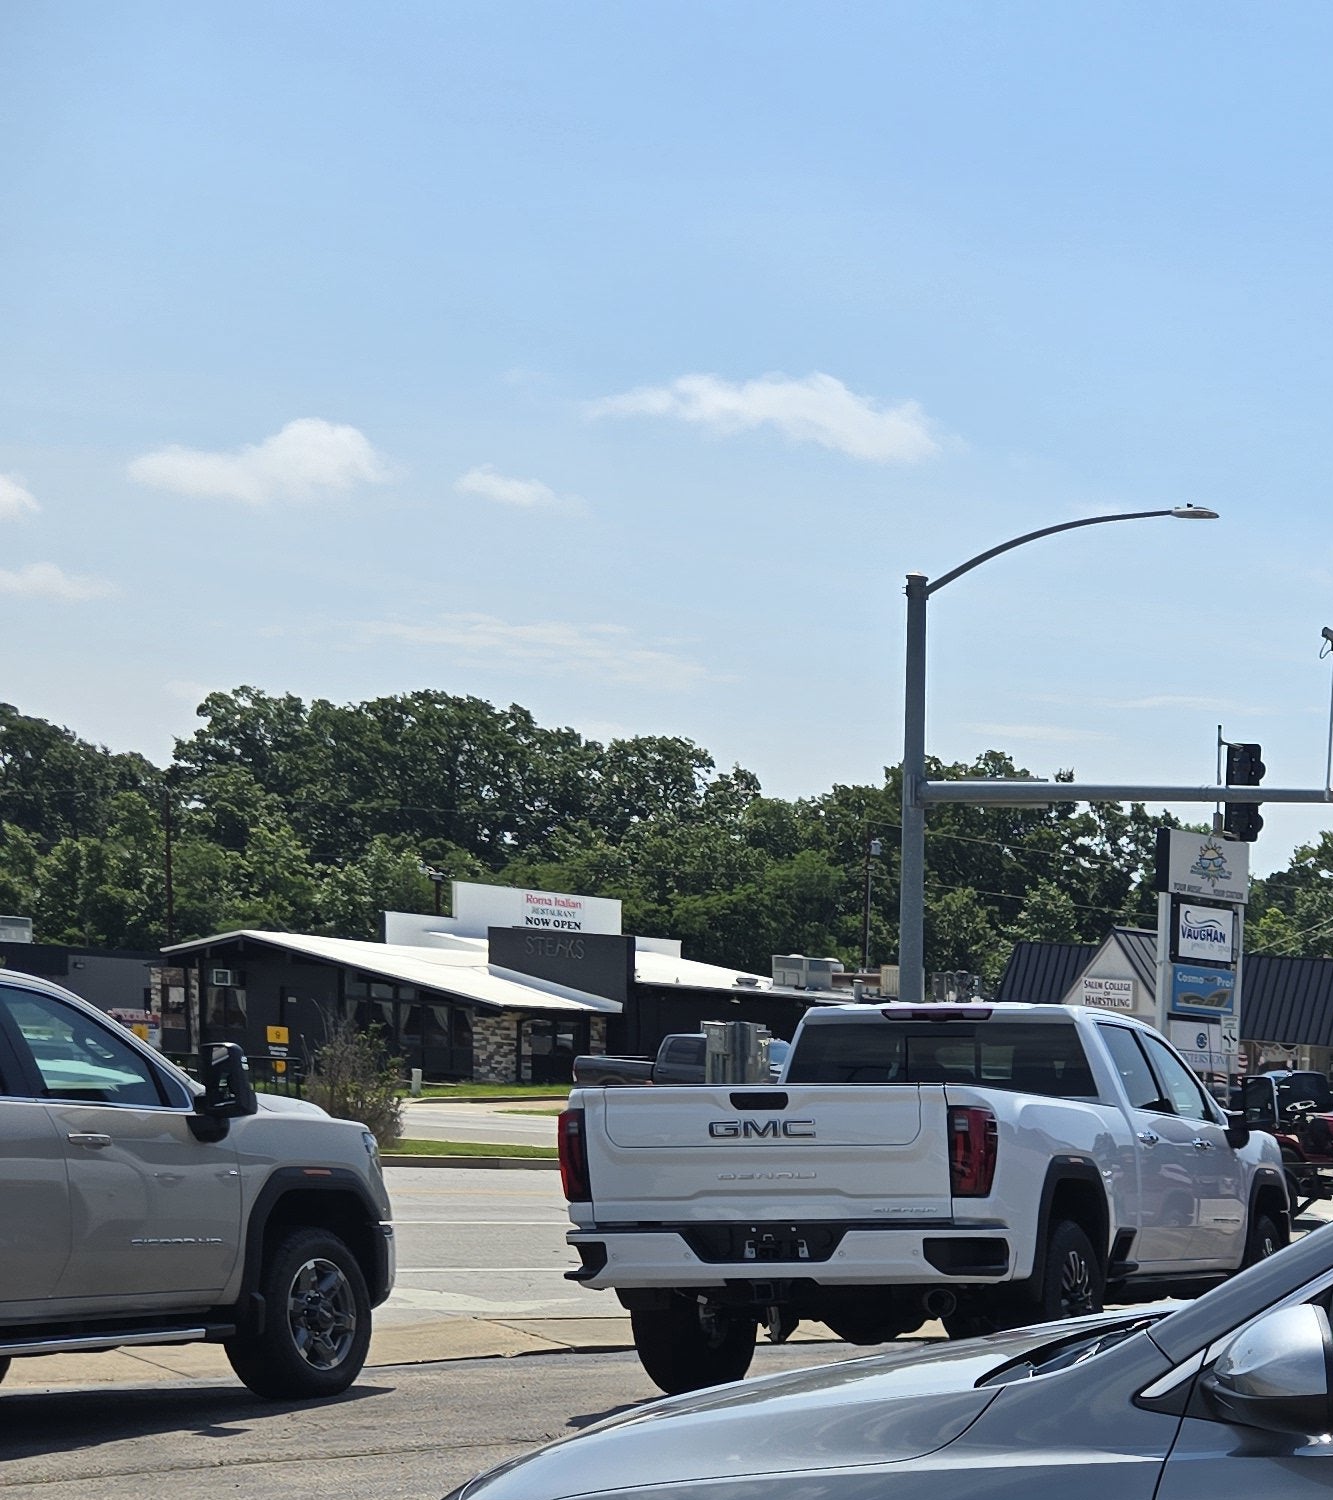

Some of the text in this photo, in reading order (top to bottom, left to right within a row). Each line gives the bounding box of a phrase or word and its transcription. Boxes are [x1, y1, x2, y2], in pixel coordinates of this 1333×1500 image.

[526, 893, 582, 909] Roma Italian
[531, 905, 577, 919] RESTAURANT
[525, 916, 582, 931] NOW OPEN
[1181, 924, 1226, 944] VAUGHAN
[525, 935, 585, 960] STEAKS
[1177, 971, 1205, 985] Cosmo
[708, 1118, 817, 1139] GMC
[717, 1171, 817, 1181] DENALI
